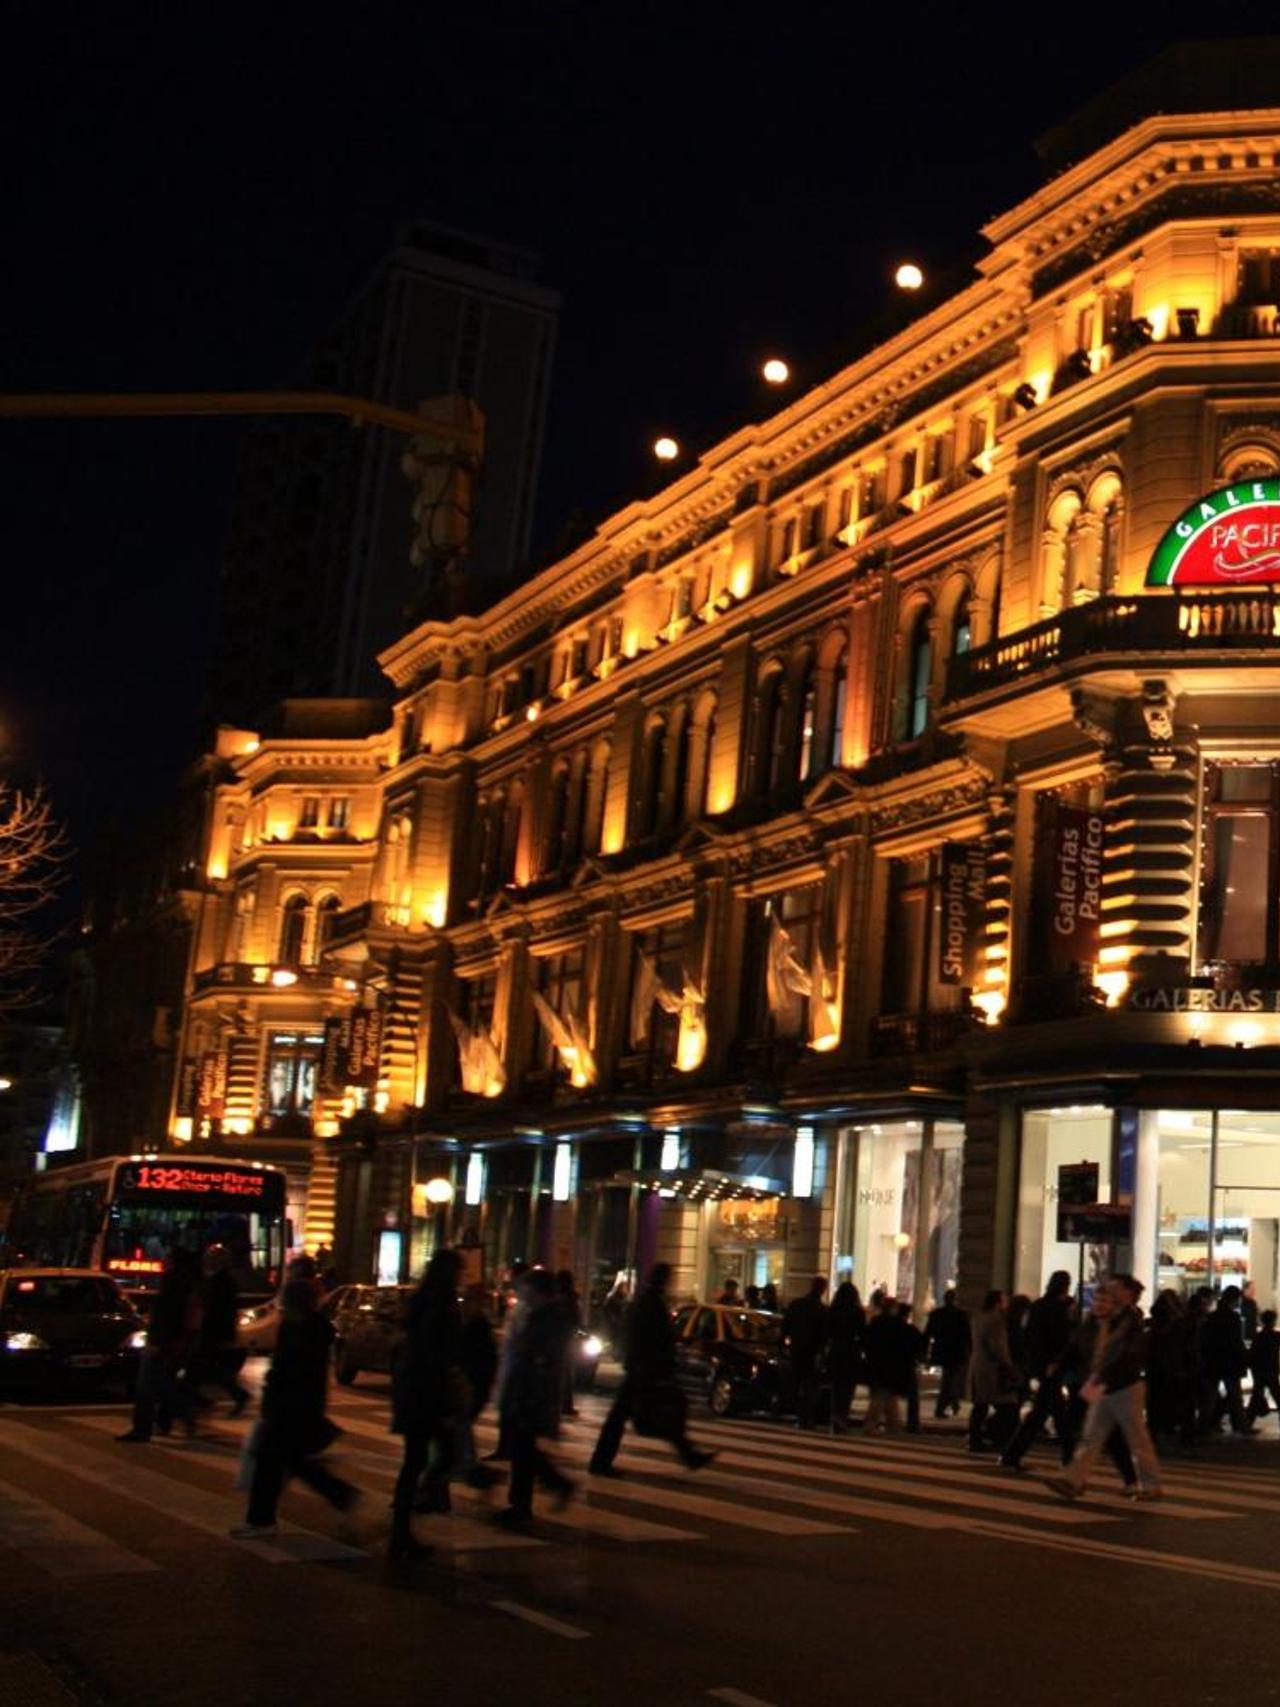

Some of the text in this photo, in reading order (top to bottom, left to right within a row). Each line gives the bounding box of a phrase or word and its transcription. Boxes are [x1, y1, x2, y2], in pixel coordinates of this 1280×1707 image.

[965, 849, 986, 901] Mall
[942, 863, 968, 977] Shopping
[1132, 987, 1263, 1012] GALERIAS
[137, 1166, 183, 1191] 132
